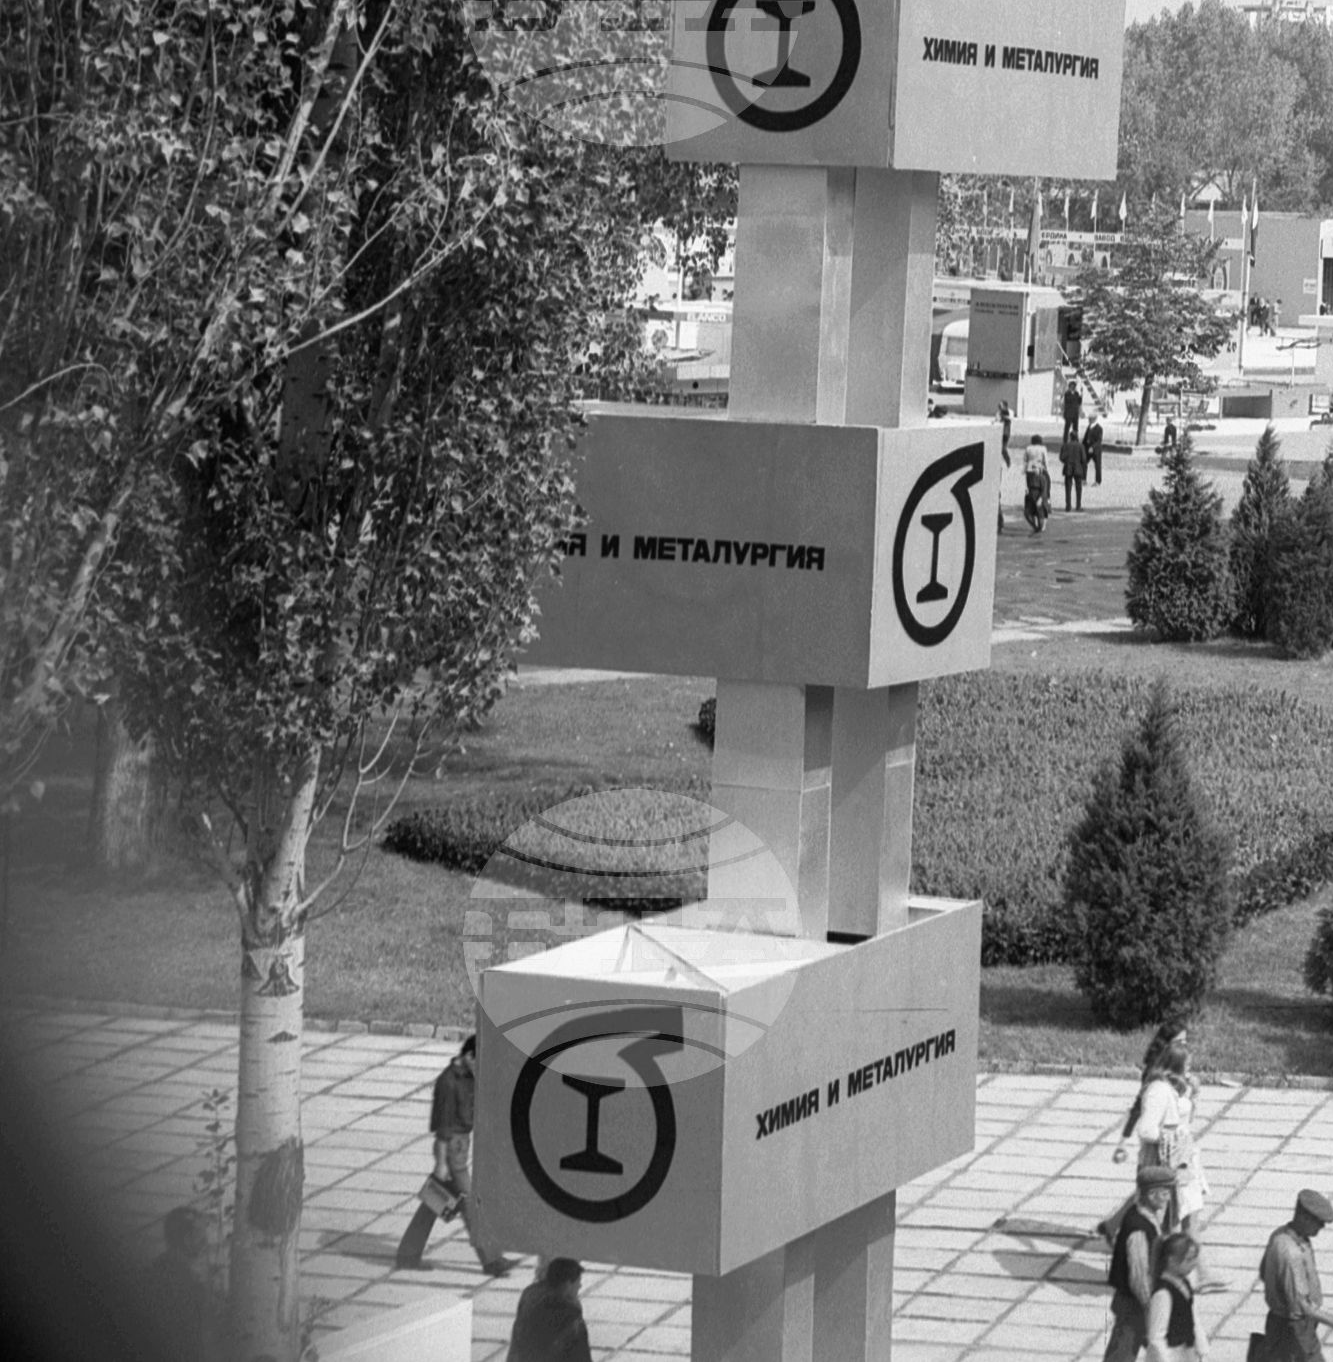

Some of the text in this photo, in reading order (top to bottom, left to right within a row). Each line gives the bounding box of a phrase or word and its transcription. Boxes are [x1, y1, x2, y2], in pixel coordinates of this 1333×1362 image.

[923, 36, 1099, 79] ХИМИЯ И МЕТАЛУРГИЯ
[600, 534, 620, 559] И
[633, 535, 825, 571] МЕТАЛУРГИЯ
[755, 1029, 956, 1141] ХИМИЯ И МЕТАЛУРГИЯ
